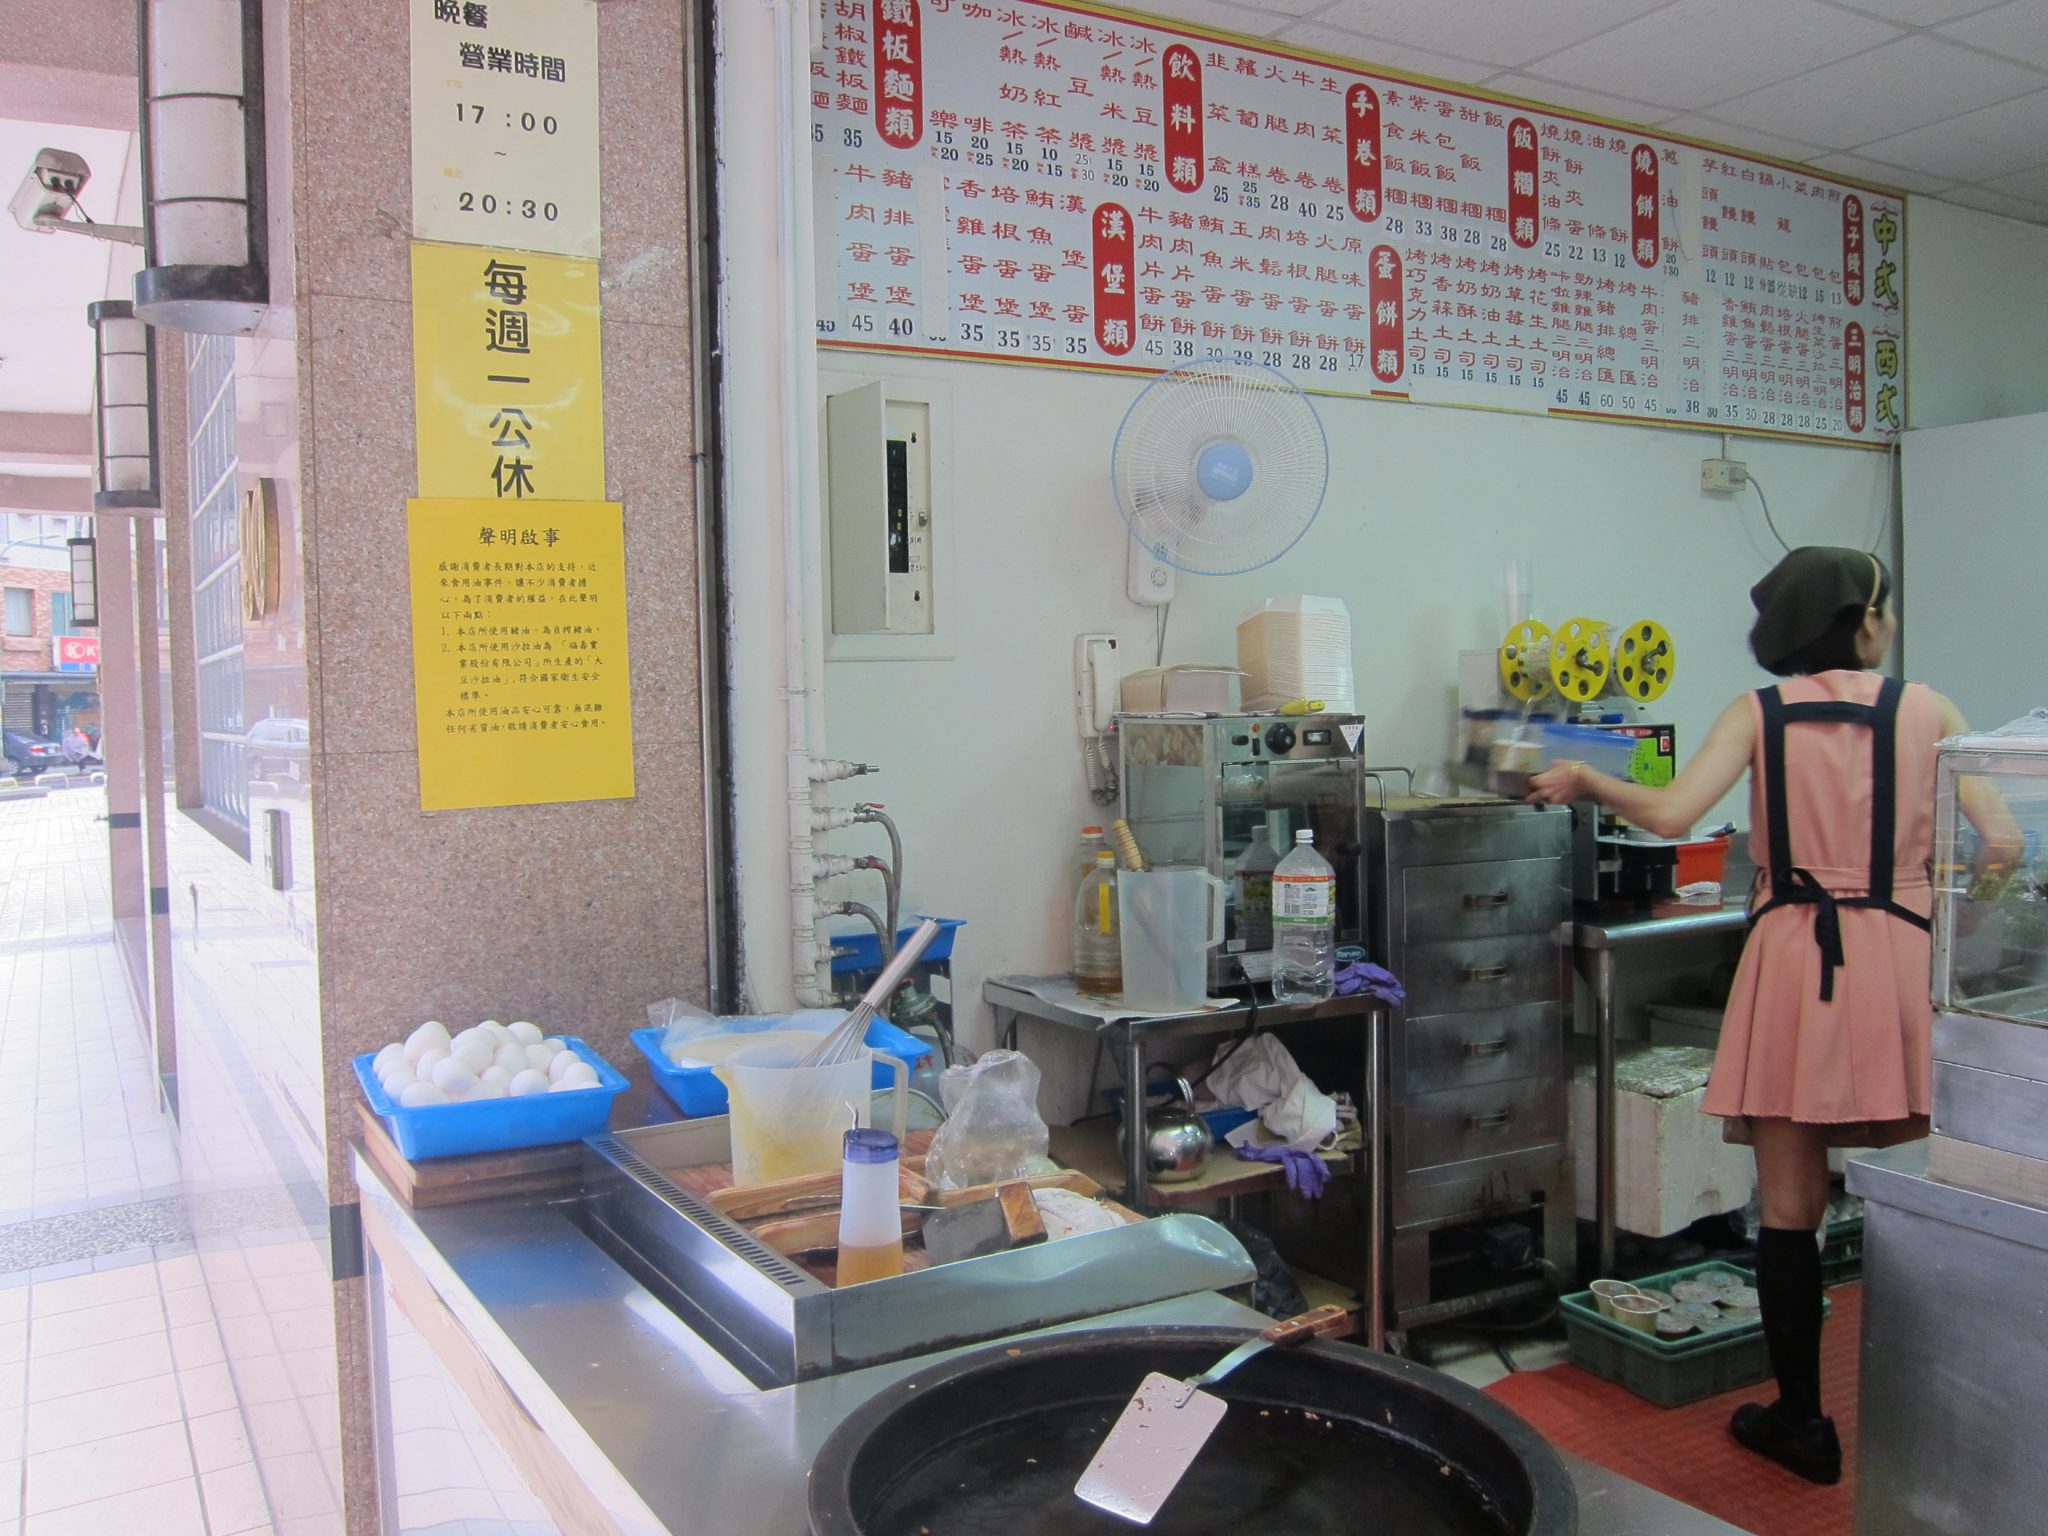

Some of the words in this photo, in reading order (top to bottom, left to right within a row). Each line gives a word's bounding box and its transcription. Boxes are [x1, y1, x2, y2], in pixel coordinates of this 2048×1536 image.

[434, 0, 488, 29] 晚餐
[459, 41, 566, 83] 營業時間
[834, 0, 869, 115] 胡椒鐵板麵
[881, 0, 914, 140] 鐵板麵類
[962, 3, 994, 135] 咖啡
[1168, 52, 1197, 187] 飲料類
[1205, 52, 1231, 175] 韭菜盒
[1291, 70, 1318, 189] 牛肉卷
[1319, 77, 1345, 194] 生菜卷
[843, 128, 862, 148] 35
[935, 131, 953, 145] 15
[971, 136, 989, 150] 20
[940, 147, 959, 161] 20
[1006, 142, 1023, 155] 15
[1041, 148, 1058, 161] 10
[1352, 90, 1377, 216] 手卷類
[976, 152, 993, 166] 25
[1012, 158, 1029, 172] 20
[1107, 158, 1123, 171] 15
[1046, 163, 1063, 177] 15
[1139, 163, 1155, 177] 15
[1540, 123, 1561, 232] 燒餅夾油條
[1112, 173, 1128, 187] 20
[1143, 179, 1160, 193] 20
[1242, 181, 1257, 194] 25
[1563, 128, 1584, 236] 燒餅夾蛋
[1587, 134, 1606, 239] 油條
[1214, 185, 1229, 203] 25
[1608, 138, 1629, 243] 燒餅
[458, 191, 559, 222] 20:30
[1246, 196, 1260, 208] 35
[1270, 194, 1289, 211] 28
[1298, 202, 1317, 218] 40
[1635, 151, 1654, 263] 燒餅類
[1326, 204, 1345, 221] 25
[845, 163, 878, 303] 牛肉蛋堡
[1385, 216, 1403, 234] 28
[1415, 221, 1433, 236] 33
[882, 168, 916, 307] 豬排蛋堡
[1440, 226, 1457, 242] 38
[1463, 229, 1481, 245] 28
[956, 179, 988, 314] 香雞蛋堡
[991, 185, 1022, 318] 培根蛋堡
[1490, 236, 1507, 252] 28
[1545, 241, 1560, 257] 25
[1025, 188, 1056, 321] 鮪魚蛋堡
[1059, 194, 1090, 323] 漢堡蛋
[1568, 245, 1583, 260] 22
[1592, 248, 1606, 262] 13
[1614, 253, 1625, 268] 12
[1873, 212, 1899, 306] 中式
[1138, 206, 1165, 332] 牛肉片蛋餅
[1168, 211, 1196, 336] 豬肉片蛋餅
[1199, 215, 1226, 339] 鮪魚蛋餅
[1101, 210, 1128, 348] 漢堡類
[1230, 221, 1255, 342] 玉米蛋餅
[1286, 230, 1312, 348] 培根蛋餅
[1315, 234, 1339, 352] 火腿蛋餅
[1341, 237, 1366, 354] 原味蛋餅
[1375, 251, 1398, 376] 蛋餅類
[852, 314, 873, 332] 45
[888, 318, 913, 336] 40
[960, 323, 984, 341] 35
[998, 330, 1020, 348] 35
[1032, 335, 1051, 351] 35
[1065, 336, 1087, 354] 35
[1146, 340, 1163, 355] 45
[1173, 340, 1193, 356] 38
[1263, 351, 1282, 368] 28
[1292, 354, 1310, 370] 28
[1319, 355, 1337, 371] 28
[1349, 354, 1364, 368] 17
[1412, 364, 1425, 375] 15
[1436, 366, 1449, 378] 15
[1461, 369, 1473, 380] 15
[1486, 372, 1497, 383] 15
[483, 258, 535, 499] 每週一公休
[1509, 375, 1521, 386] 15
[1533, 377, 1544, 388] 15
[1875, 340, 1899, 429] 西式
[1556, 389, 1568, 403] 45
[1579, 391, 1590, 405] 45
[1600, 394, 1614, 407] 60
[1622, 396, 1635, 409] 50
[1644, 398, 1656, 411] 45
[1686, 399, 1700, 414] 38
[1725, 405, 1738, 418] 35
[1763, 411, 1776, 424] 28
[1781, 413, 1793, 426] 28
[1799, 415, 1810, 427] 28
[1815, 417, 1827, 430] 25
[479, 527, 561, 548] 聲明啟事
